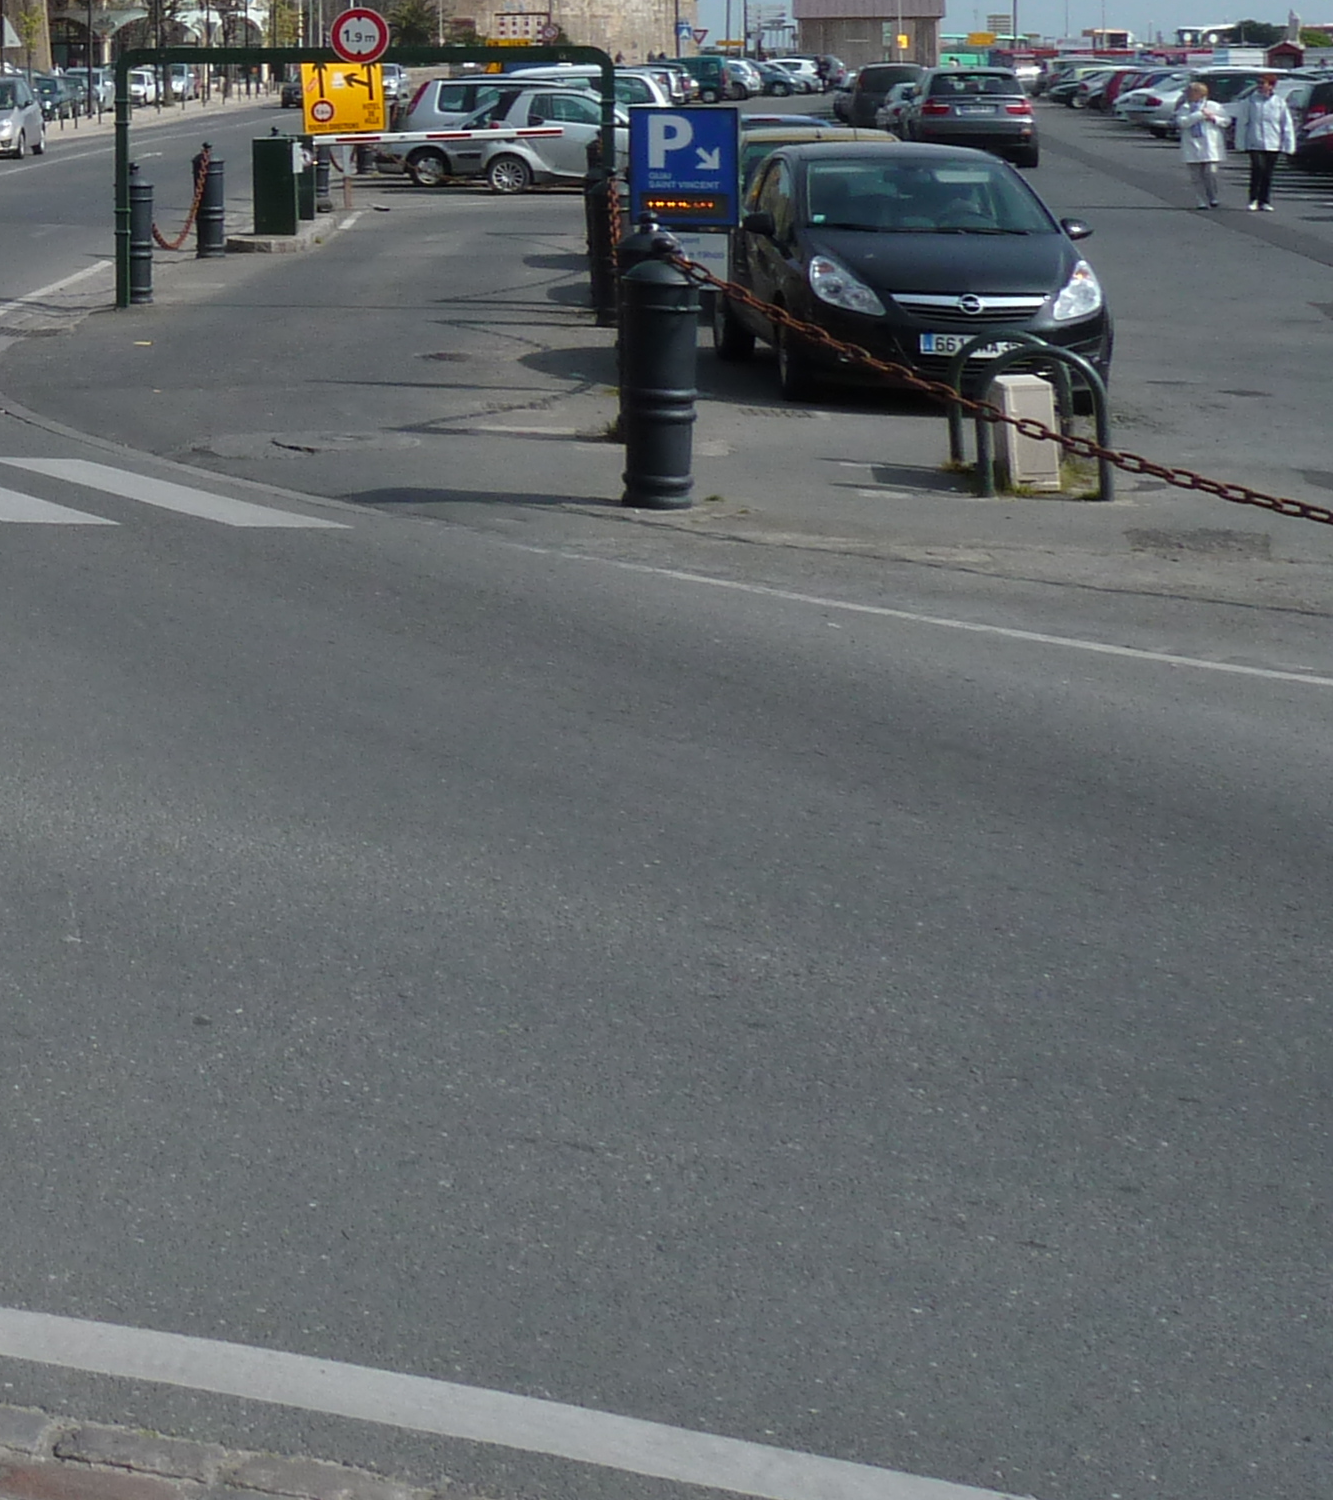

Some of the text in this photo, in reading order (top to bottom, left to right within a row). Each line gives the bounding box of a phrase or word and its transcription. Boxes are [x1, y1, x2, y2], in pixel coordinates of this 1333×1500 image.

[343, 29, 376, 43] 1.9 m
[648, 114, 693, 169] P
[648, 171, 672, 180] QUAI
[648, 180, 720, 190] SAINT VINCENT
